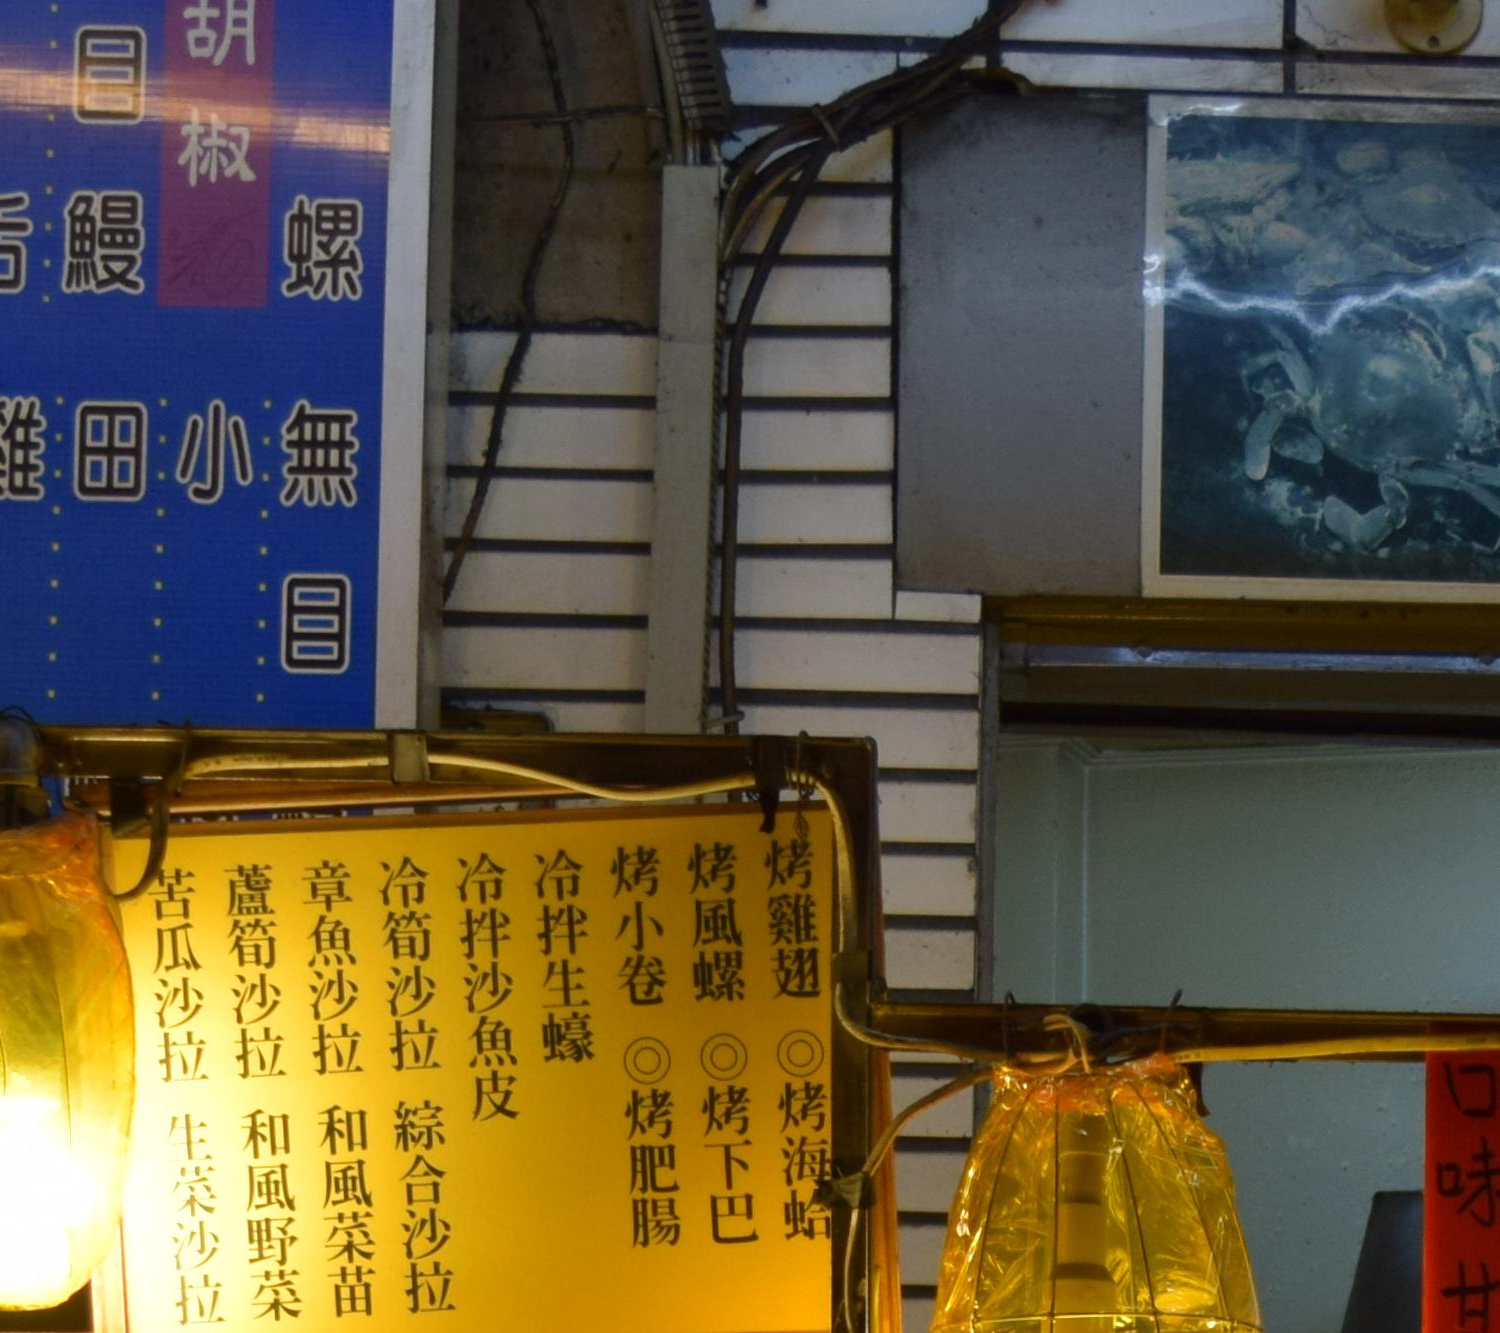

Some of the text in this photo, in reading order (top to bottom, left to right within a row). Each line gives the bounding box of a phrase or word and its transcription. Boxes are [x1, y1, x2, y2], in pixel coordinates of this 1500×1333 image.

[176, 0, 257, 188] 胡椒
[282, 195, 363, 303] 螺
[150, 868, 226, 1329] 苦瓜沙拉 生菜沙拉
[223, 862, 302, 1324] 蘆筍沙拉 和風野菜
[301, 857, 378, 1319] 章魚沙拉 和風菜苗
[378, 855, 457, 1315] 冷筍沙拉 綜合沙拉
[457, 851, 519, 1123] 冷拌沙魚皮
[533, 848, 597, 1065] 冷拌生蠔
[610, 844, 682, 1250] 烤小卷 烤肥腸
[687, 841, 759, 1245] 烤風螺 烤下巴
[765, 839, 822, 1000] 烤雞翅
